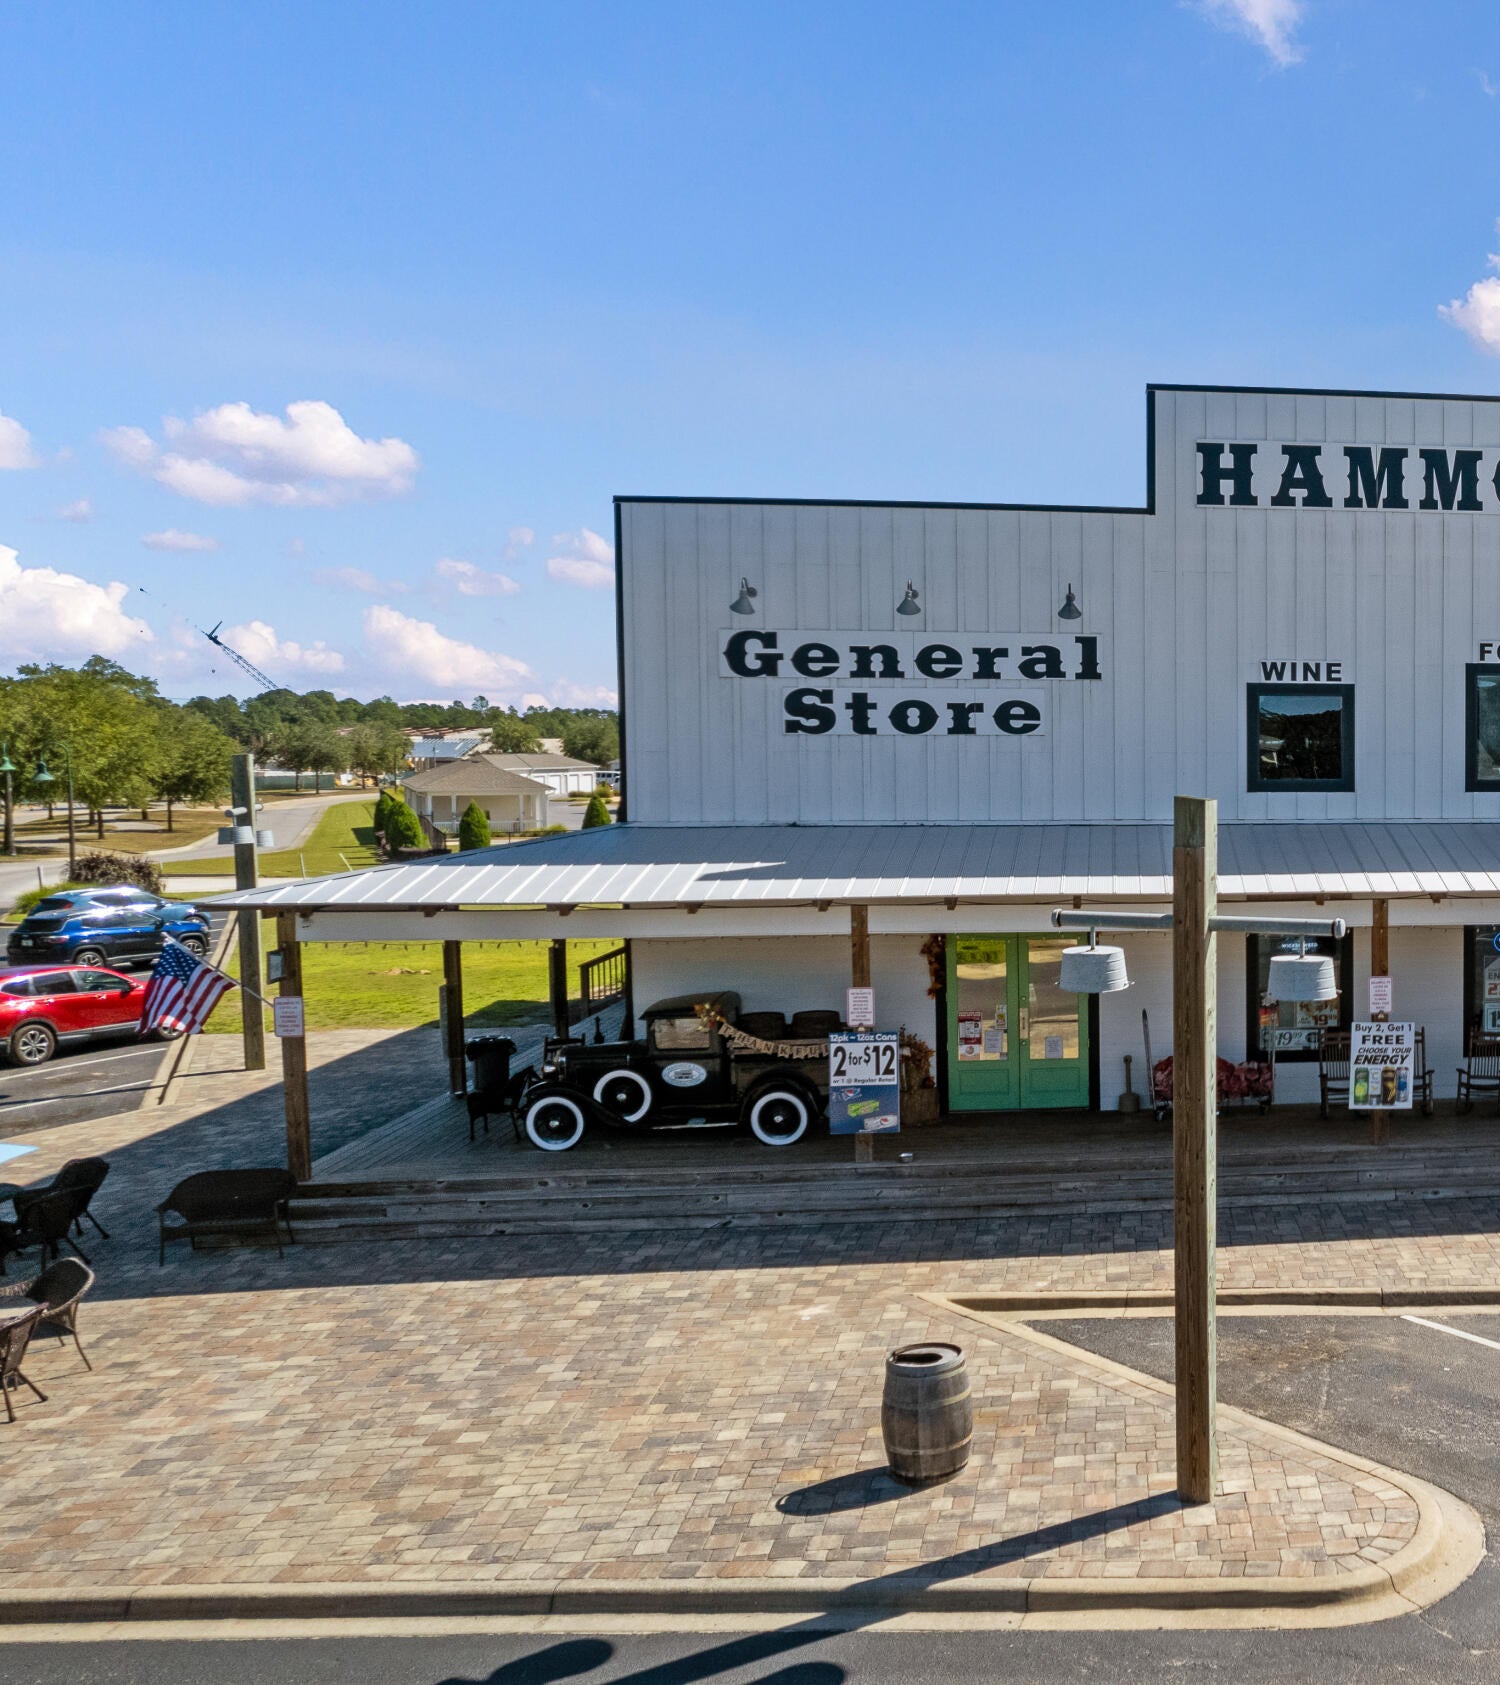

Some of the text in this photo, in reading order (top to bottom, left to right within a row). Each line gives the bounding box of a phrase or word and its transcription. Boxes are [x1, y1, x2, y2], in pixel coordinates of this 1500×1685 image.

[723, 630, 1102, 680] General
[1261, 661, 1343, 682] WINE
[784, 688, 1041, 735] Store
[1355, 1024, 1372, 1033] Buy
[1376, 1024, 1384, 1032] 2,
[830, 1034, 849, 1042] 12pk
[875, 1033, 897, 1041] Cans
[1362, 1035, 1405, 1045] FREE
[833, 1045, 895, 1077] 2 for $12
[1354, 1055, 1409, 1065] ENERGY
